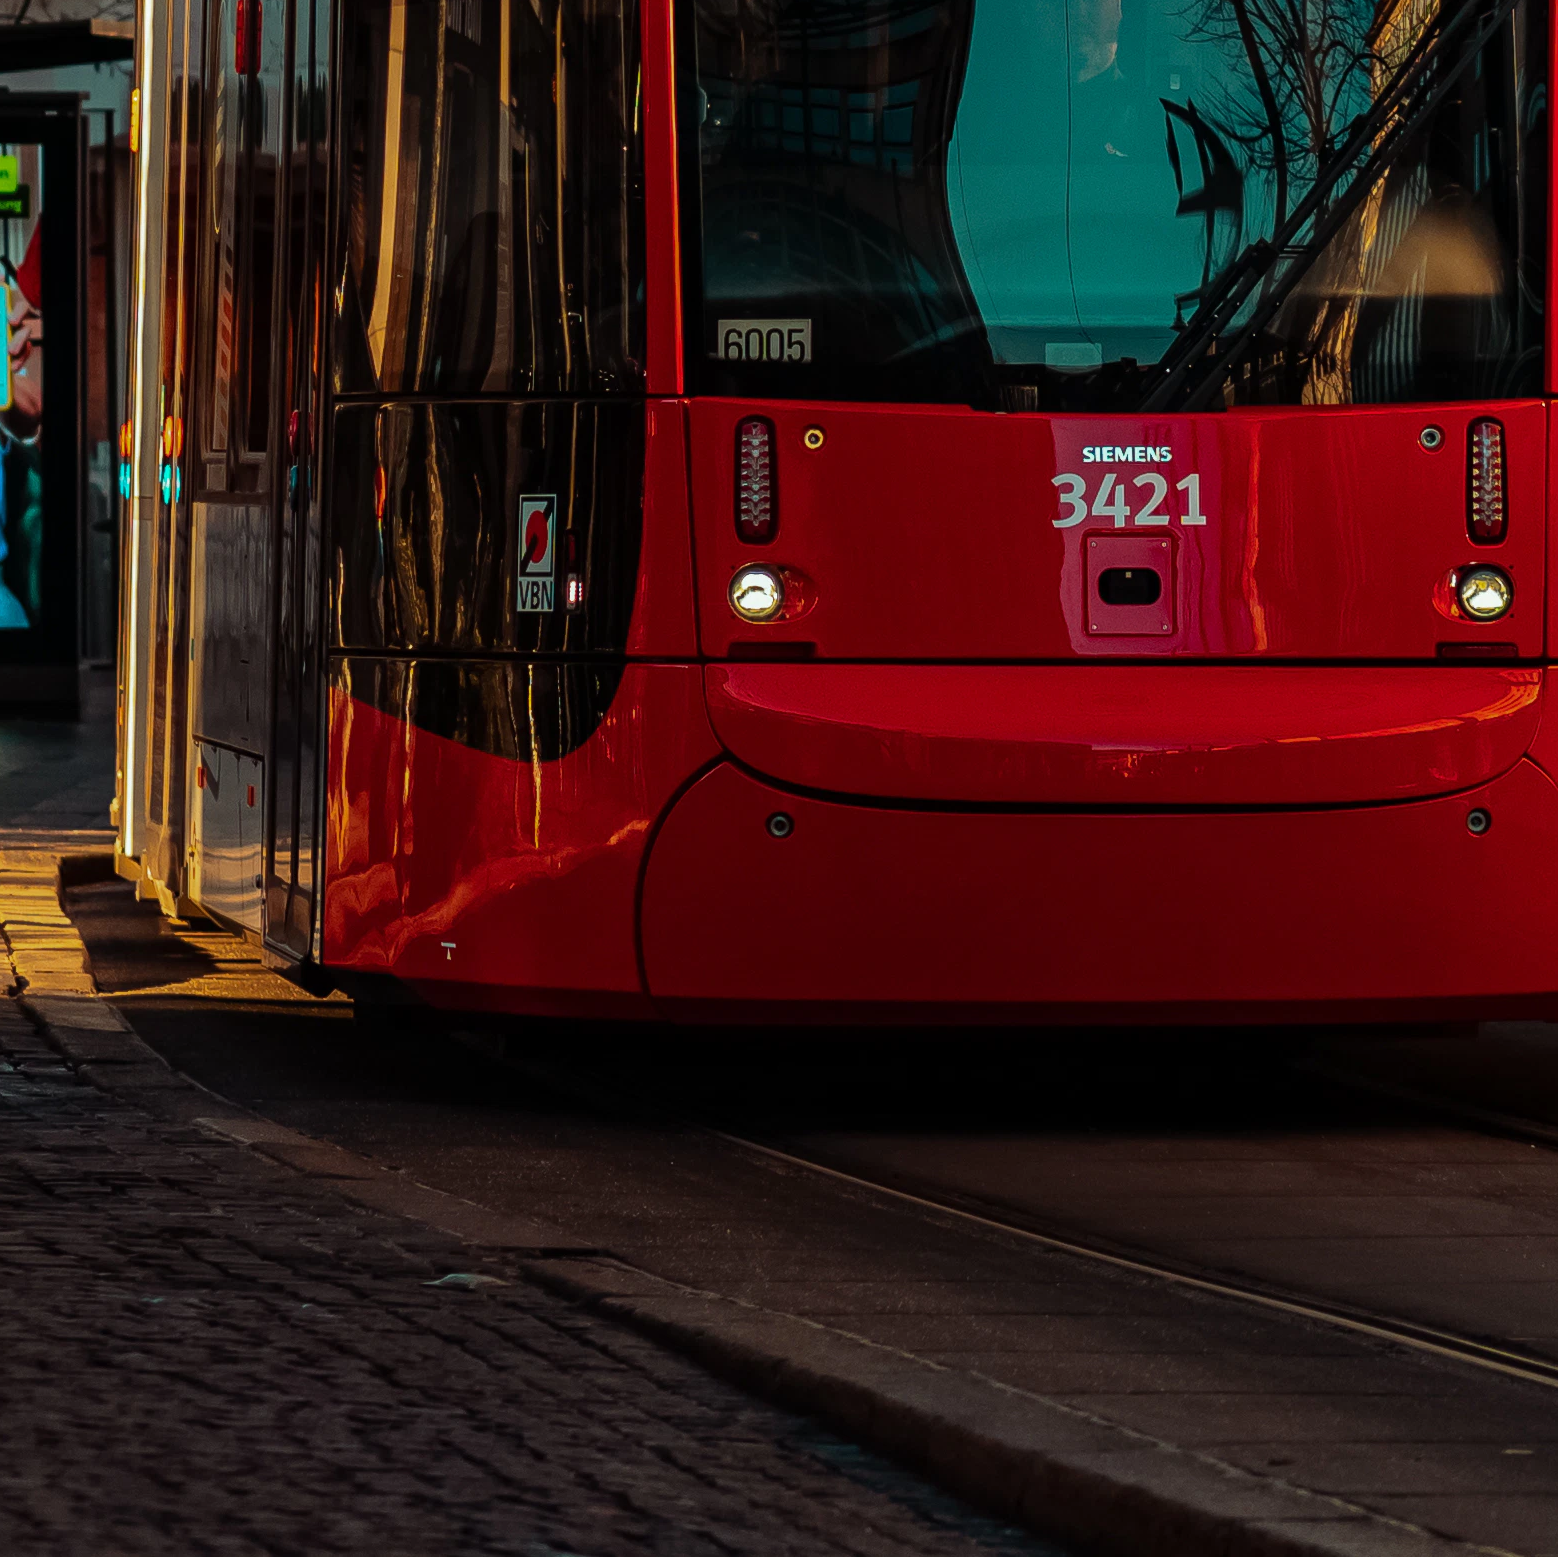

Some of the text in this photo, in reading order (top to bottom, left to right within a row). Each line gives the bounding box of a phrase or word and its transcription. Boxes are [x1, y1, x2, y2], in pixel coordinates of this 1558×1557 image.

[723, 327, 806, 362] 6005
[1082, 445, 1173, 463] SIEMENS
[1050, 472, 1208, 529] 3421
[518, 580, 554, 610] VBN
